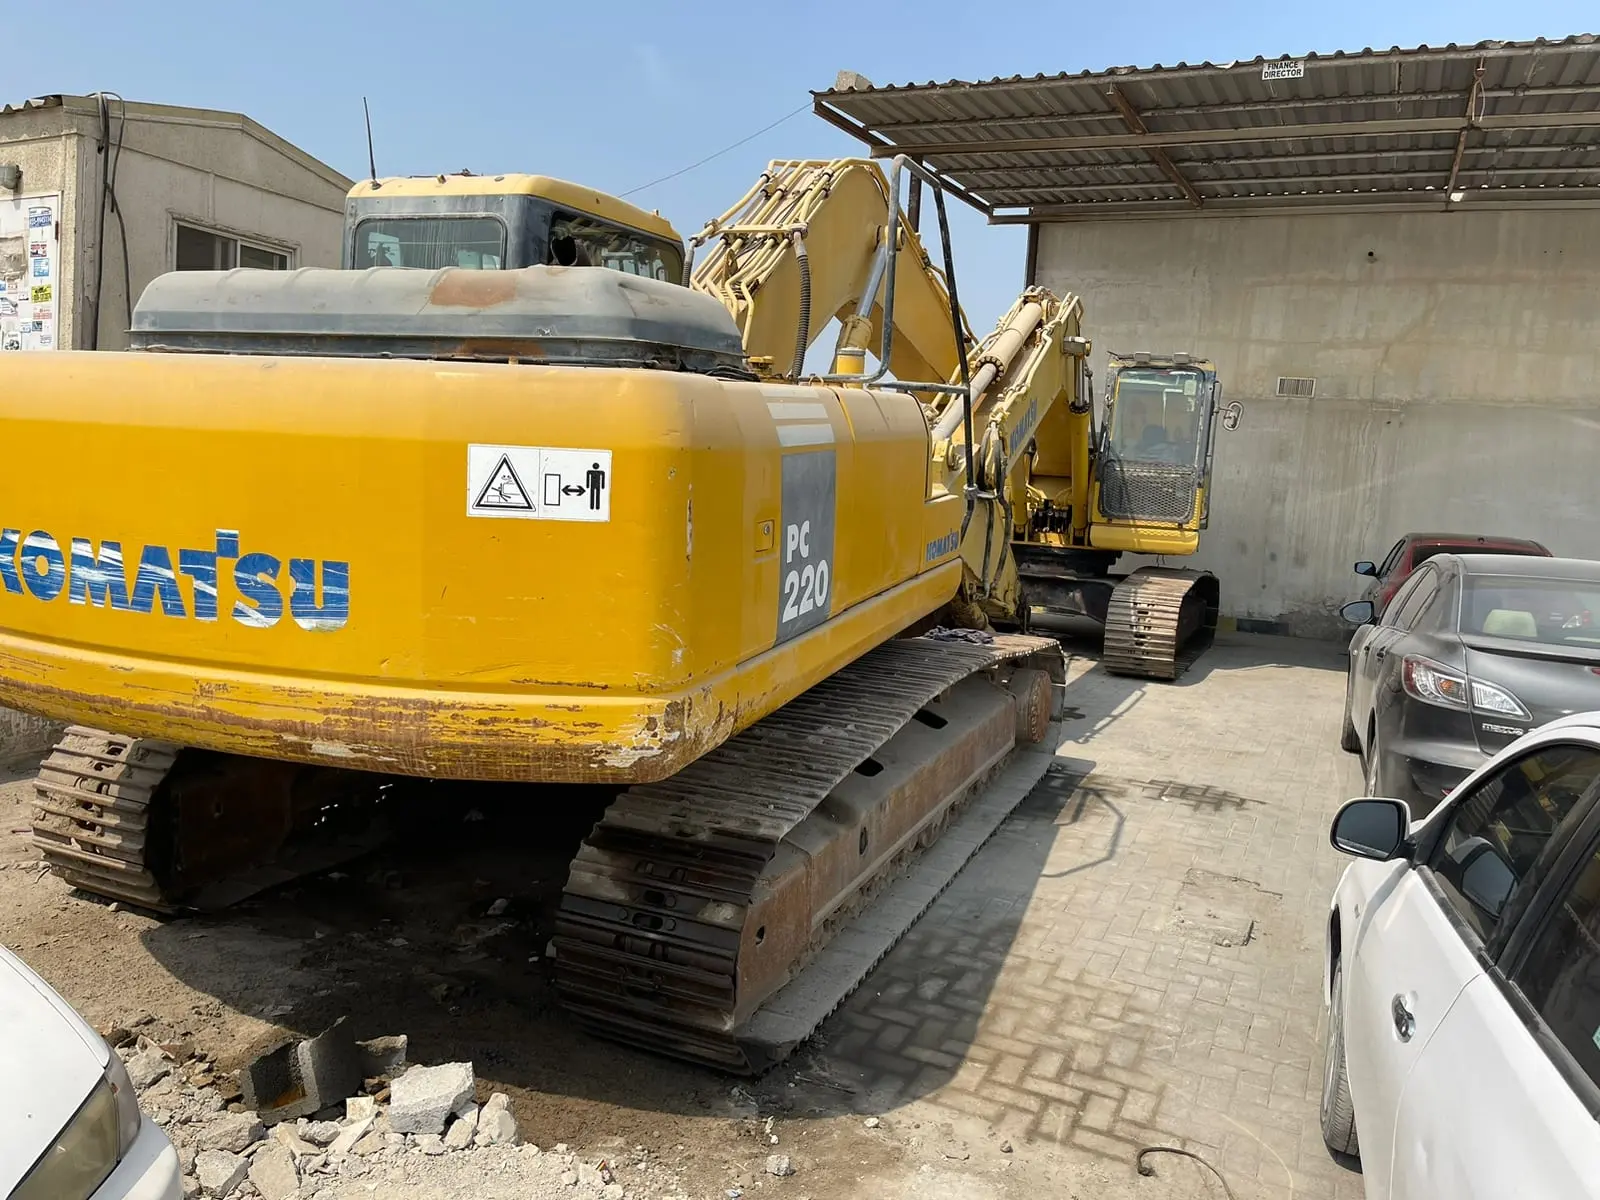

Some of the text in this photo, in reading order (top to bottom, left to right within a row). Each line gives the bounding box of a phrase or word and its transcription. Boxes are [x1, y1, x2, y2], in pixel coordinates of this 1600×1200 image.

[1264, 69, 1302, 78] DIRECTOR
[1267, 61, 1298, 70] FINANCE
[786, 520, 810, 563] PC
[926, 528, 959, 561] KOMATSU
[782, 560, 829, 624] 220
